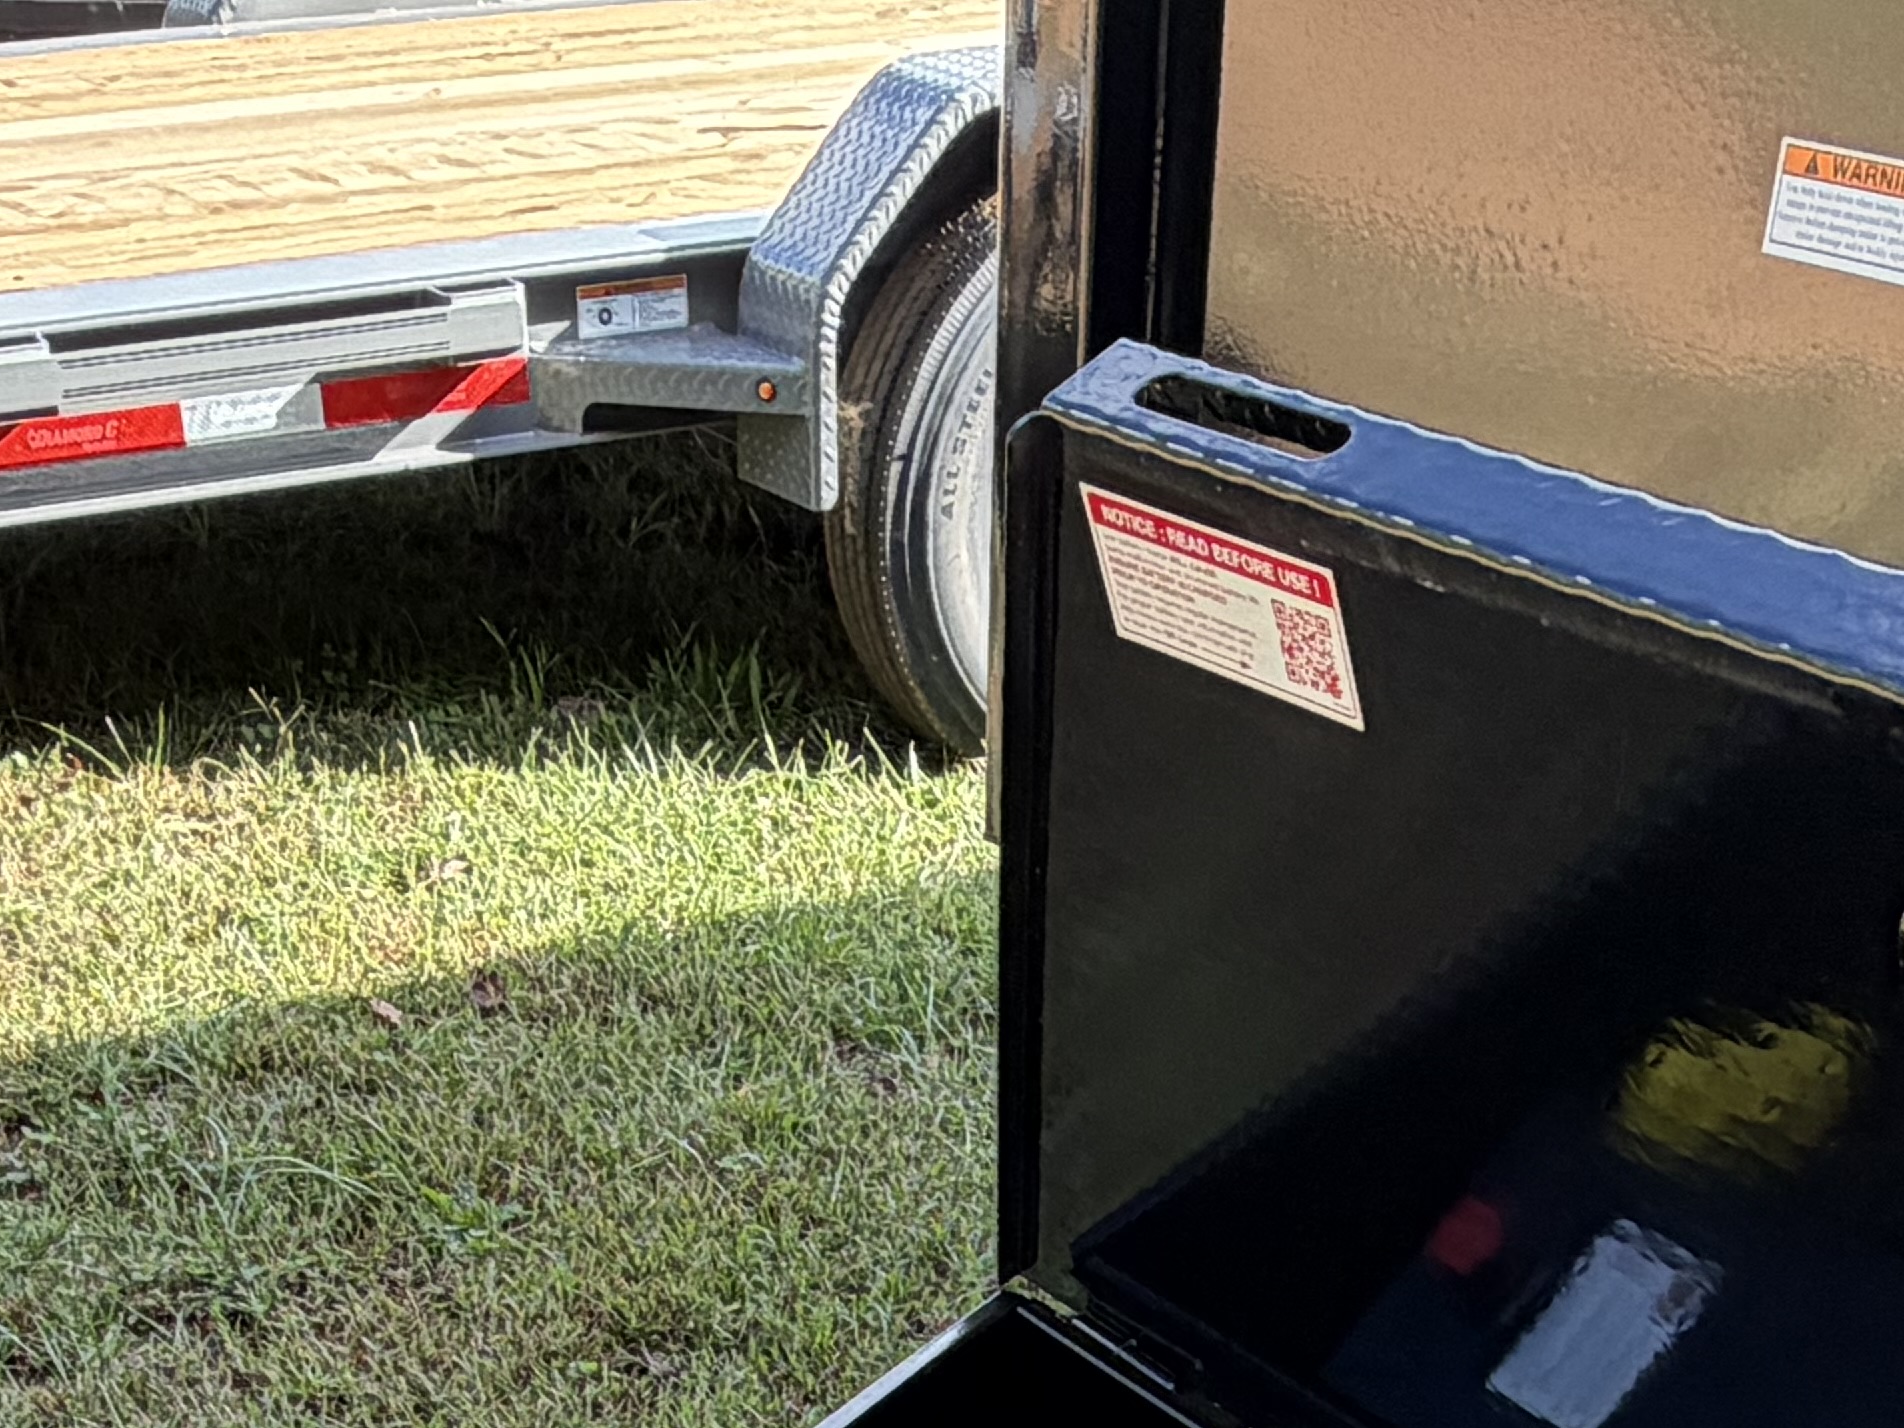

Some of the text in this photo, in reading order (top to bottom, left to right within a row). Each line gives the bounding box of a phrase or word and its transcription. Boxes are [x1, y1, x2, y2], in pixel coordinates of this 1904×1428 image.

[940, 464, 961, 520] ALL
[1100, 504, 1155, 538] NOTICE
[1165, 526, 1210, 557] READ
[1212, 542, 1275, 581] BEFORE
[1277, 566, 1311, 595] USE
